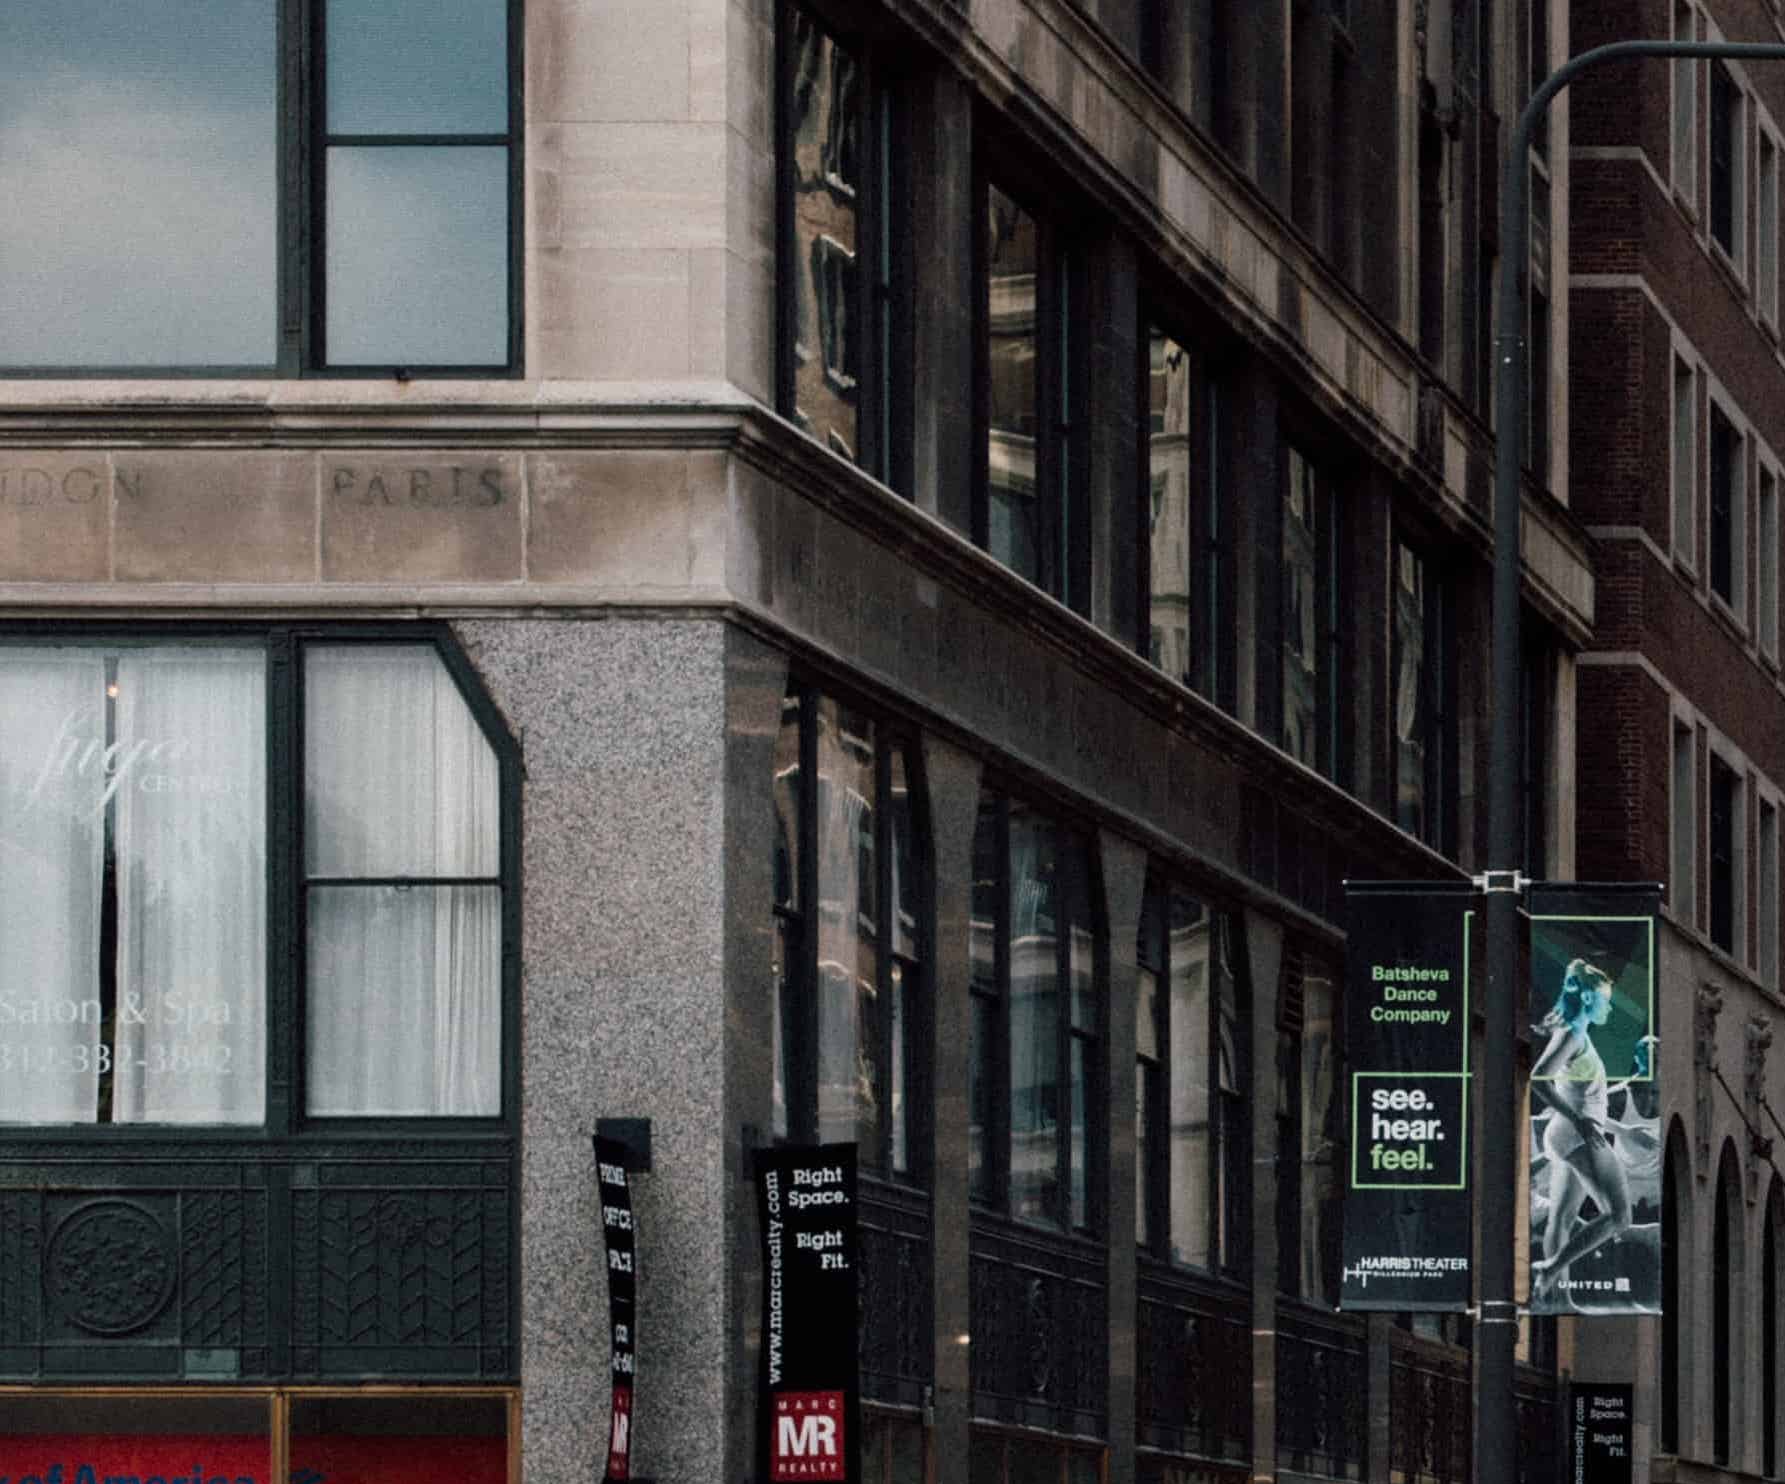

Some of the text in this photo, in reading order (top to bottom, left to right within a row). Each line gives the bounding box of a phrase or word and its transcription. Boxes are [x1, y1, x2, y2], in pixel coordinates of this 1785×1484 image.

[332, 467, 506, 505] PARIS
[1372, 966, 1449, 981] Batsheva
[1384, 986, 1437, 1001] Dance
[164, 991, 231, 1033] Spa
[1370, 1006, 1451, 1024] Company
[1372, 1089, 1434, 1111] see.
[1372, 1112, 1445, 1140] hear.
[1370, 1143, 1434, 1170] feel.
[793, 1167, 843, 1187] Right
[788, 1190, 849, 1209] Space.
[796, 1230, 843, 1250] Right
[821, 1253, 849, 1269] Fit.
[1361, 1257, 1468, 1270] HARRIS THEATER
[766, 1170, 784, 1385] www.marcrealty.com
[1558, 1280, 1613, 1289] UNITED
[778, 1400, 836, 1410] MARC
[778, 1415, 837, 1457] MR
[778, 1463, 837, 1473] REALTY
